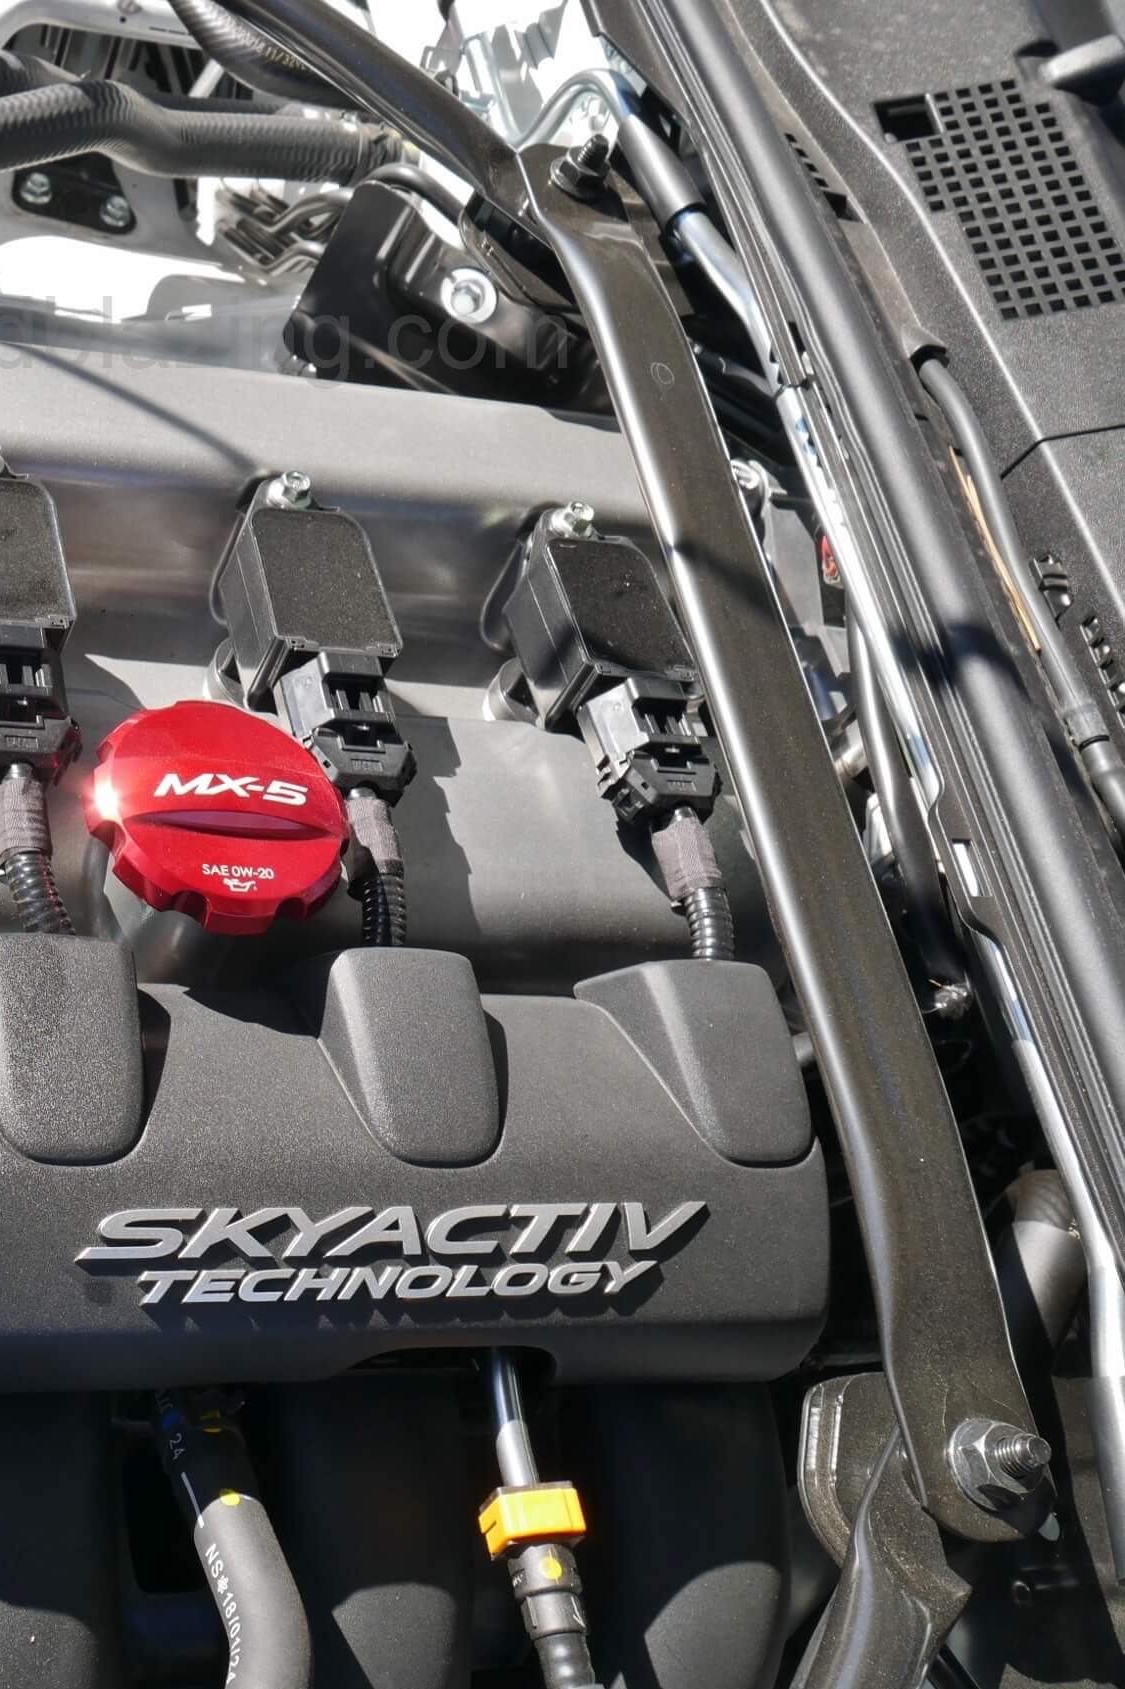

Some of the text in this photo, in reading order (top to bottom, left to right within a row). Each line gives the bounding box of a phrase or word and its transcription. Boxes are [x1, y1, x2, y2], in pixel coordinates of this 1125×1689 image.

[153, 773, 309, 806] MX-5
[202, 863, 275, 880] SAE 0W-20
[75, 1201, 708, 1263] SKYACTIV
[137, 1260, 658, 1306] TECHNOLOGY
